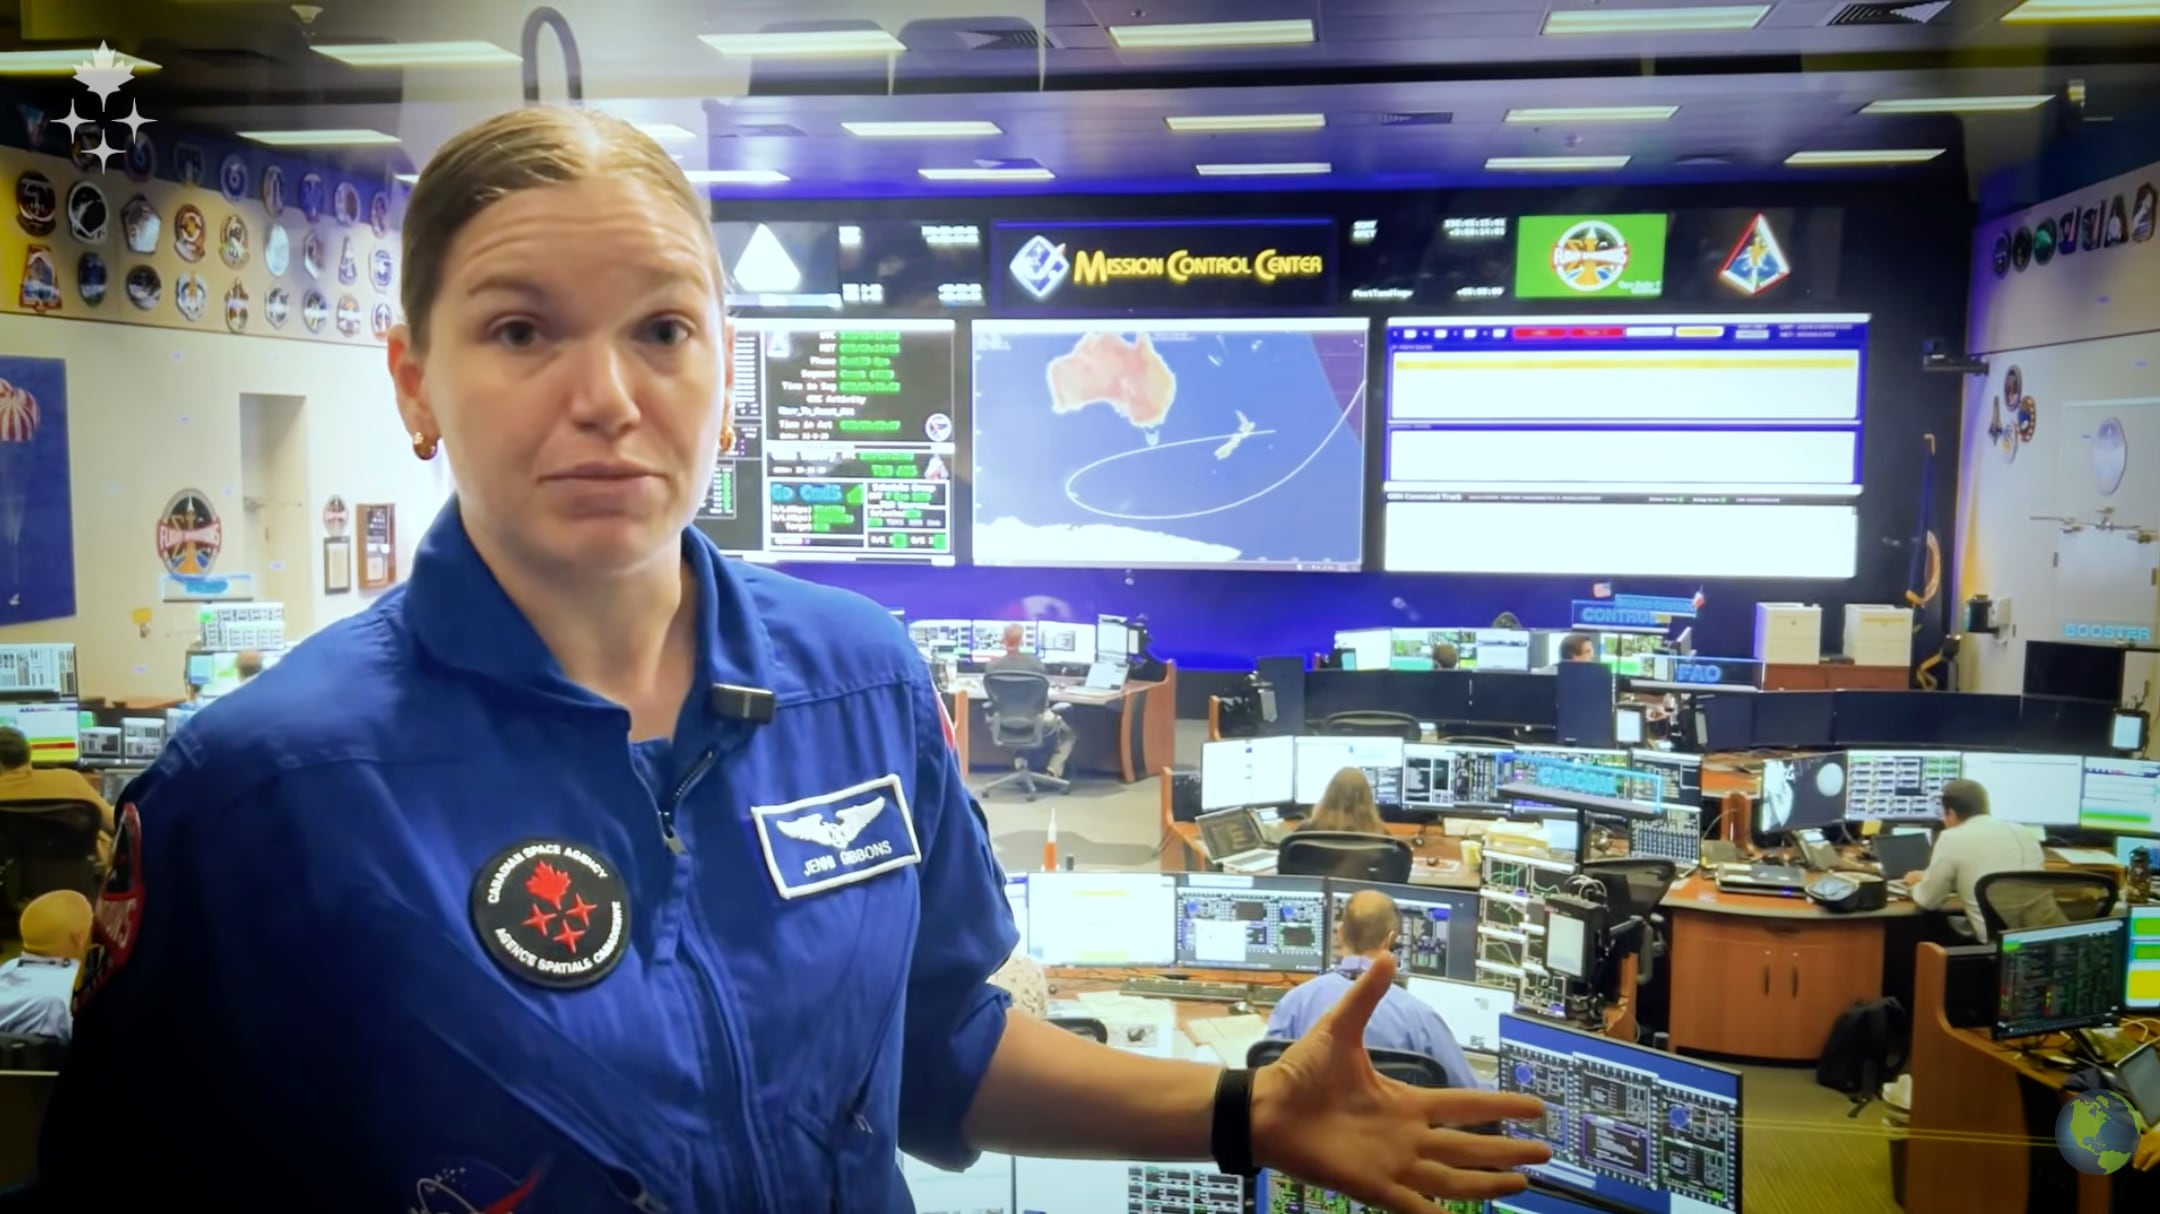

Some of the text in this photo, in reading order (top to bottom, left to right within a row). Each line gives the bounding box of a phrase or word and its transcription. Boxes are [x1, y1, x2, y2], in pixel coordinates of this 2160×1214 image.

[2063, 623, 2151, 640] BOOSTER
[1676, 663, 1722, 684] FAO
[839, 840, 893, 866] GIBBONS
[487, 844, 608, 904] CANADIAN SPACE AGENCY
[494, 927, 538, 967] AGENCE
[537, 957, 594, 974] SPATIALE
